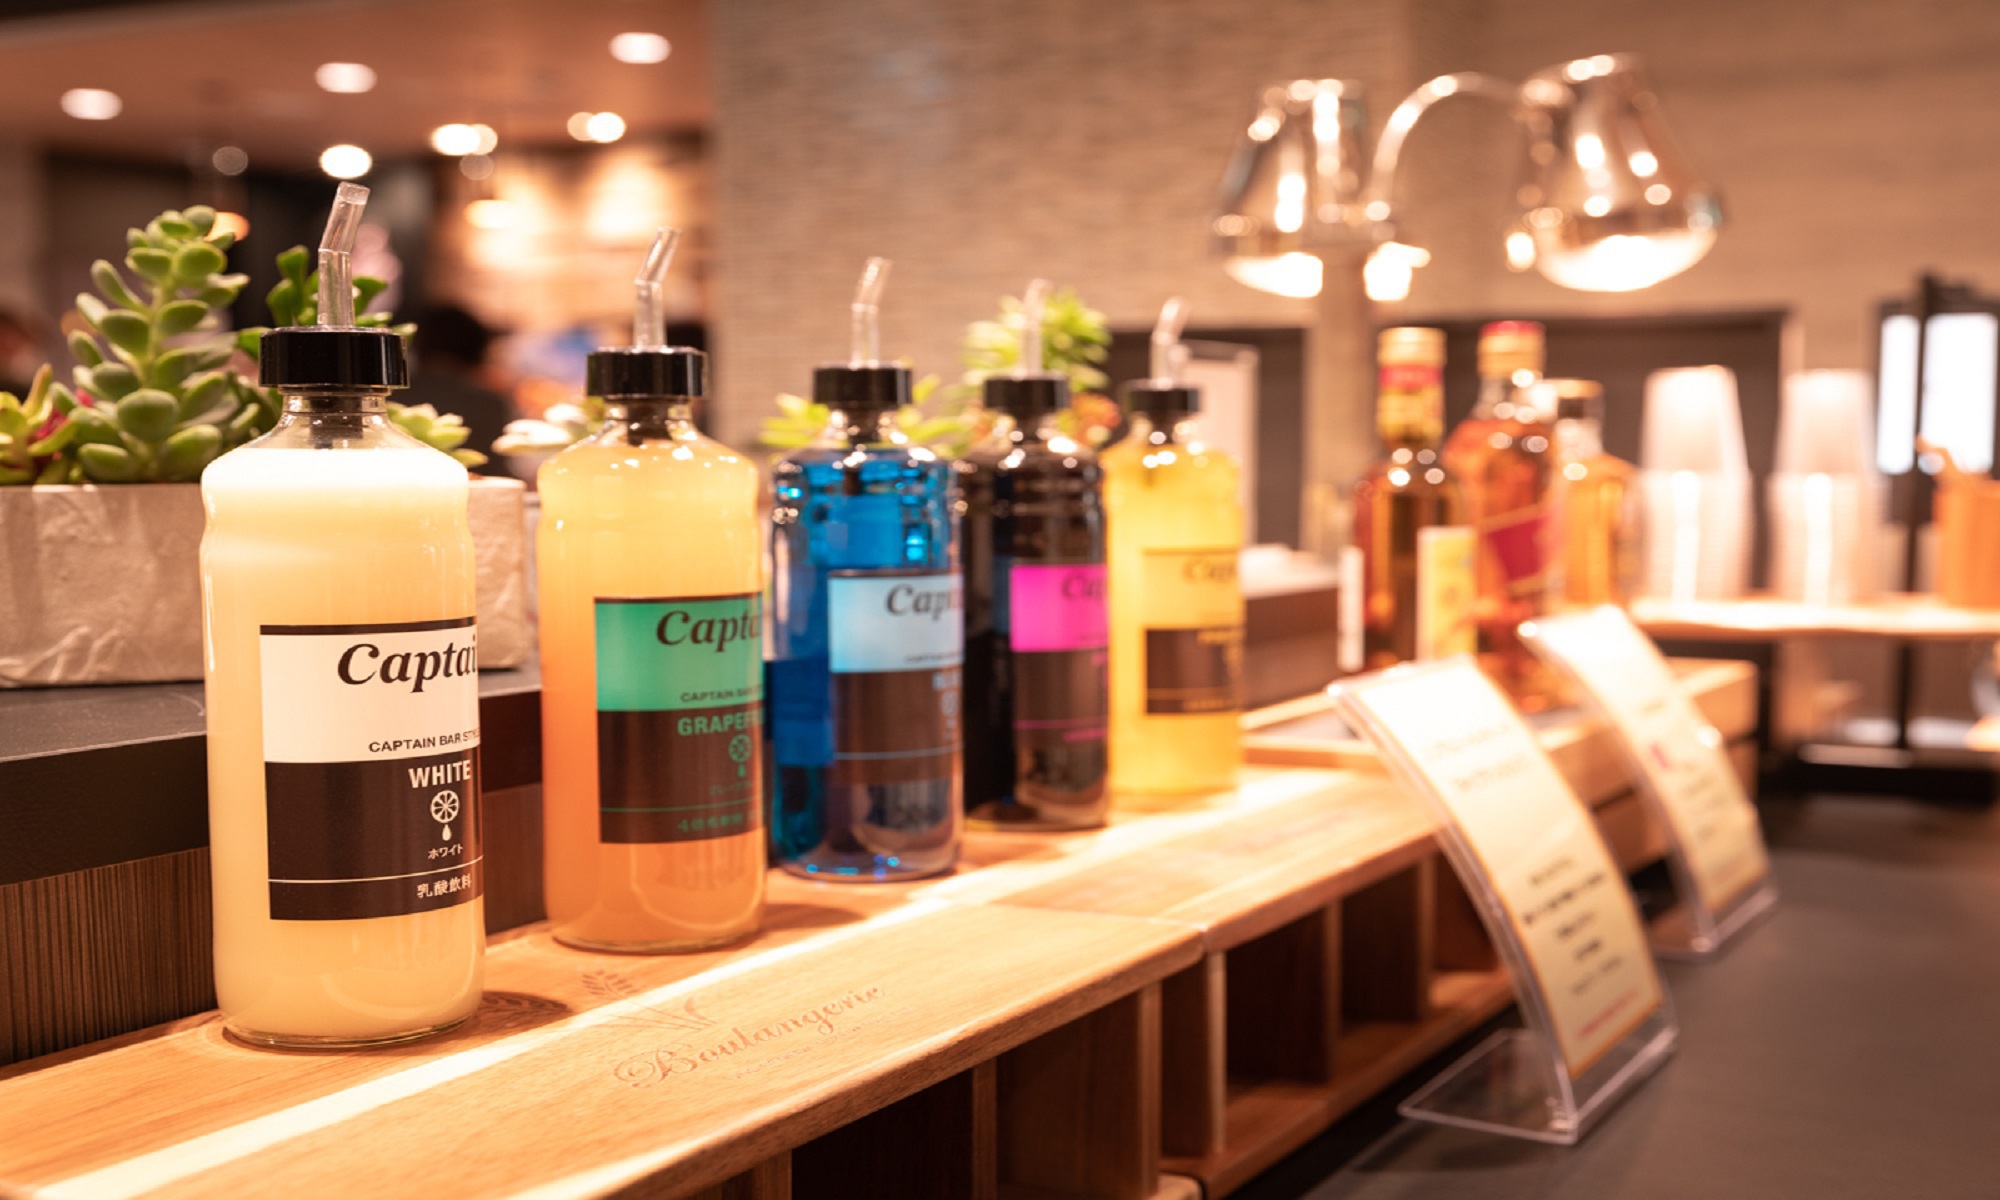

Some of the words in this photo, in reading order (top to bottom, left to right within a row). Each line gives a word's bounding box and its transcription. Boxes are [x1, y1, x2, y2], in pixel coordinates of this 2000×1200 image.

[368, 736, 436, 753] CAPTAIN
[439, 732, 462, 746] BAR
[408, 759, 471, 789] WHITE
[427, 843, 464, 860] ホワイト
[417, 872, 472, 899] 乳酸飲料
[613, 987, 886, 1088] Boulangerie
